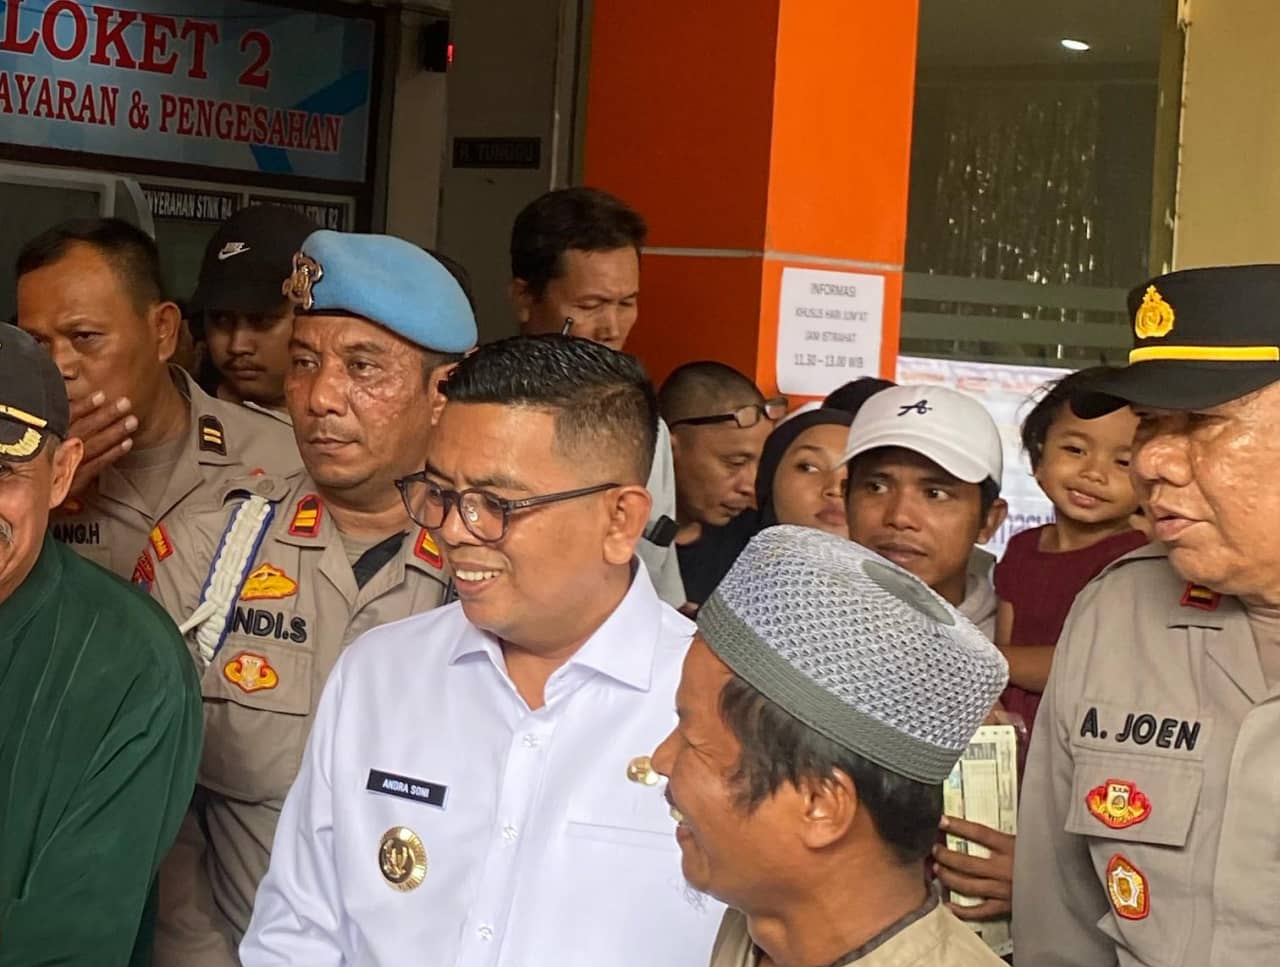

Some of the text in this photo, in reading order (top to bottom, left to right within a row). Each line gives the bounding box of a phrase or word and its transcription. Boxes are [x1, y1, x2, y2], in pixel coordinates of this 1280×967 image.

[0, 0, 274, 89] LOKET 2
[128, 92, 150, 131] &
[160, 94, 344, 154] PENGESAHAN
[144, 190, 195, 217] NYERAHAN
[810, 283, 856, 297] INFORMASI
[848, 356, 864, 368] WIB
[1080, 706, 1202, 751] A. JOEN
[382, 778, 430, 798] ANDRA SONI
